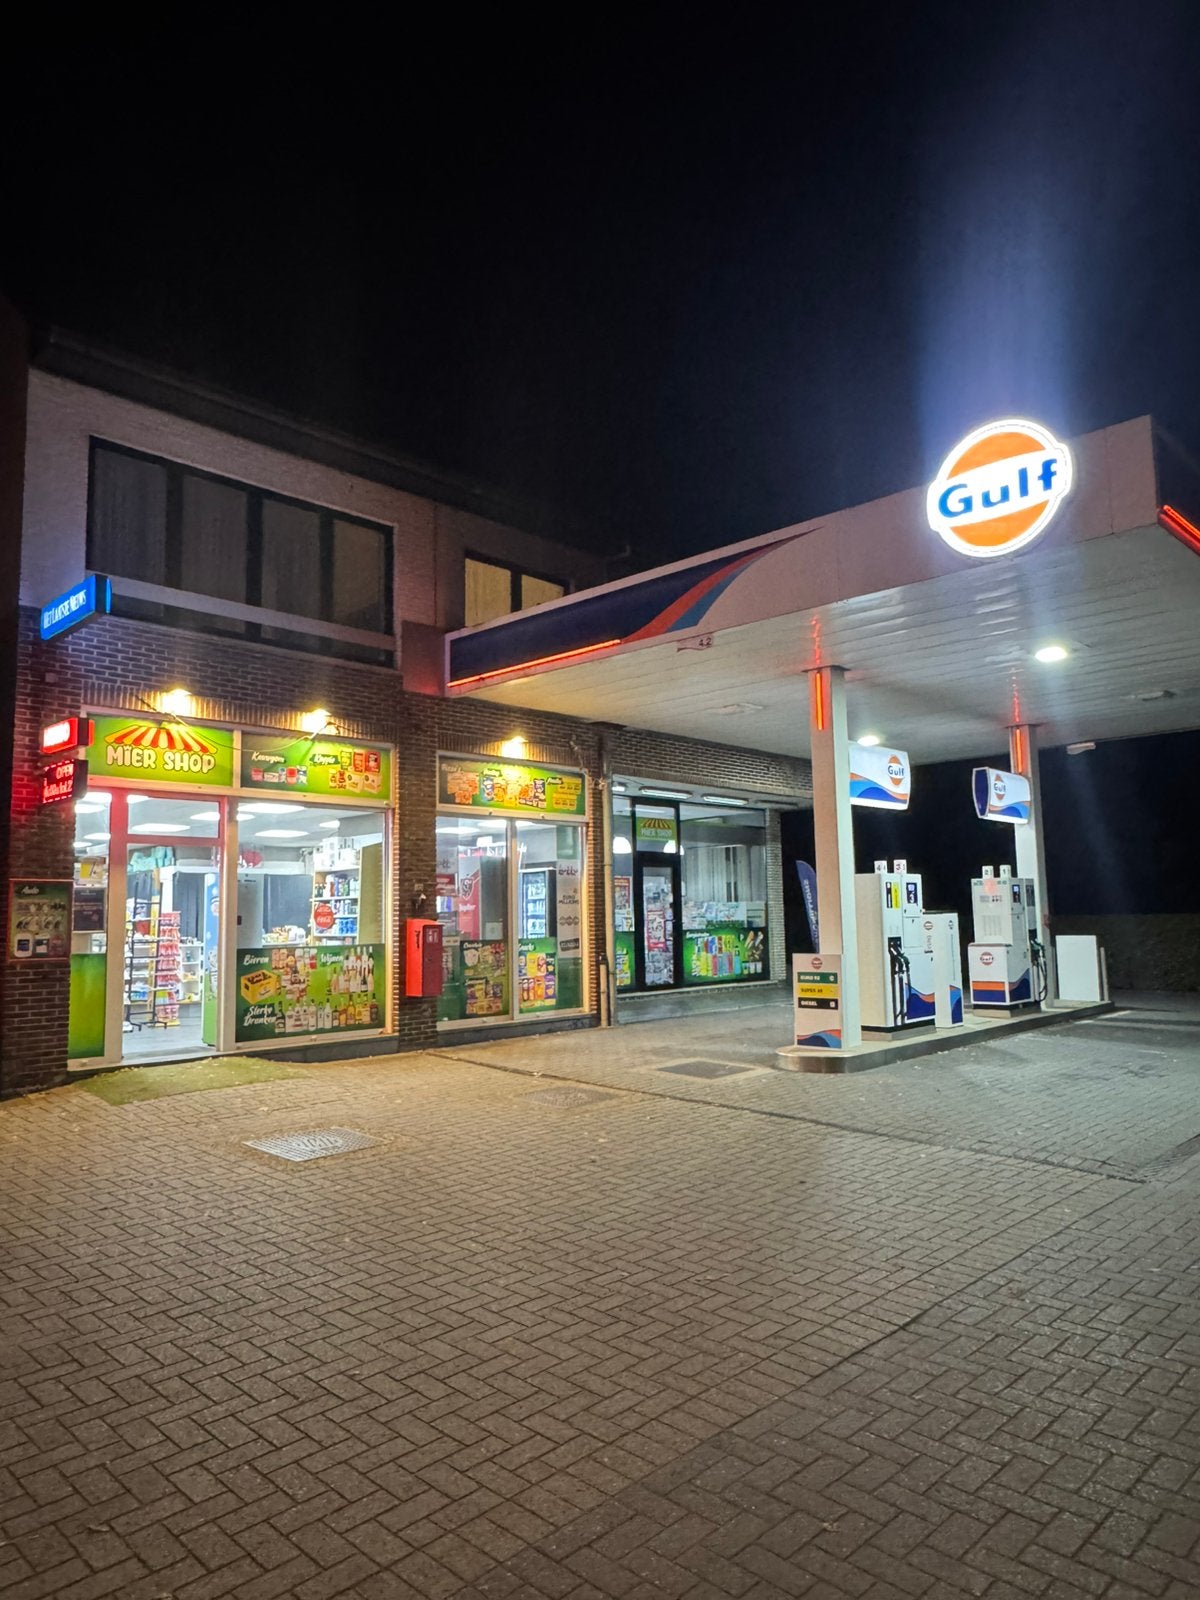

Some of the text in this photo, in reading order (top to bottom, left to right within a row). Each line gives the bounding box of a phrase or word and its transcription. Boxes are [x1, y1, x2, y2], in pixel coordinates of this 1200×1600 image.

[938, 459, 1057, 518] Gulf
[106, 745, 216, 774] MIER SHOP
[888, 765, 905, 776] Gulf
[994, 783, 1006, 792] Gulf
[243, 954, 269, 965] Bieren
[248, 1005, 273, 1017] Sterke
